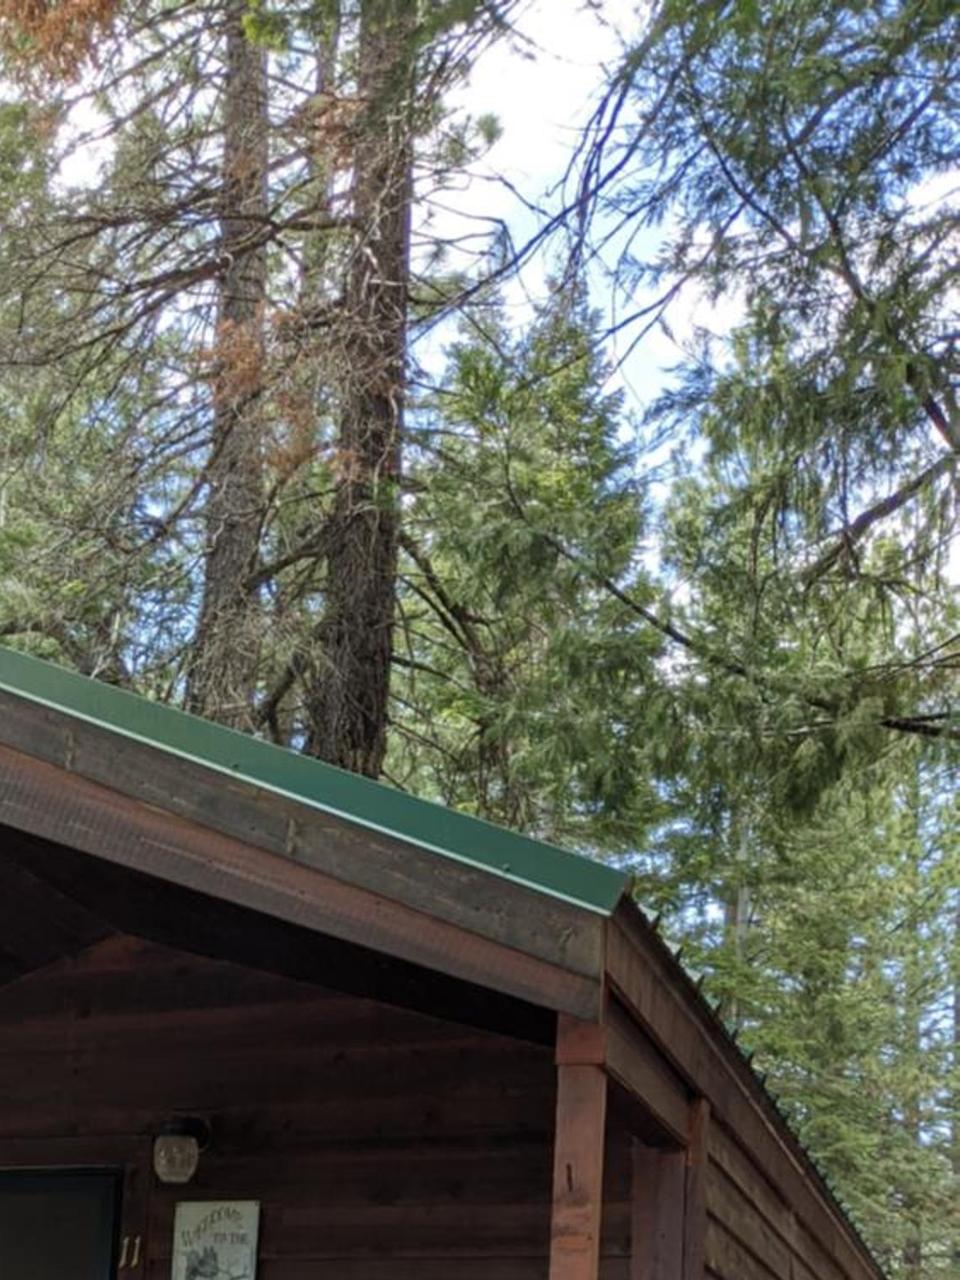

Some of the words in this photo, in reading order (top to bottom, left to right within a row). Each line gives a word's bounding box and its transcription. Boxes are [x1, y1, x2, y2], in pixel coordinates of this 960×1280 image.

[214, 1232, 227, 1244] TO
[229, 1232, 248, 1245] THE
[118, 1236, 141, 1268] 11
